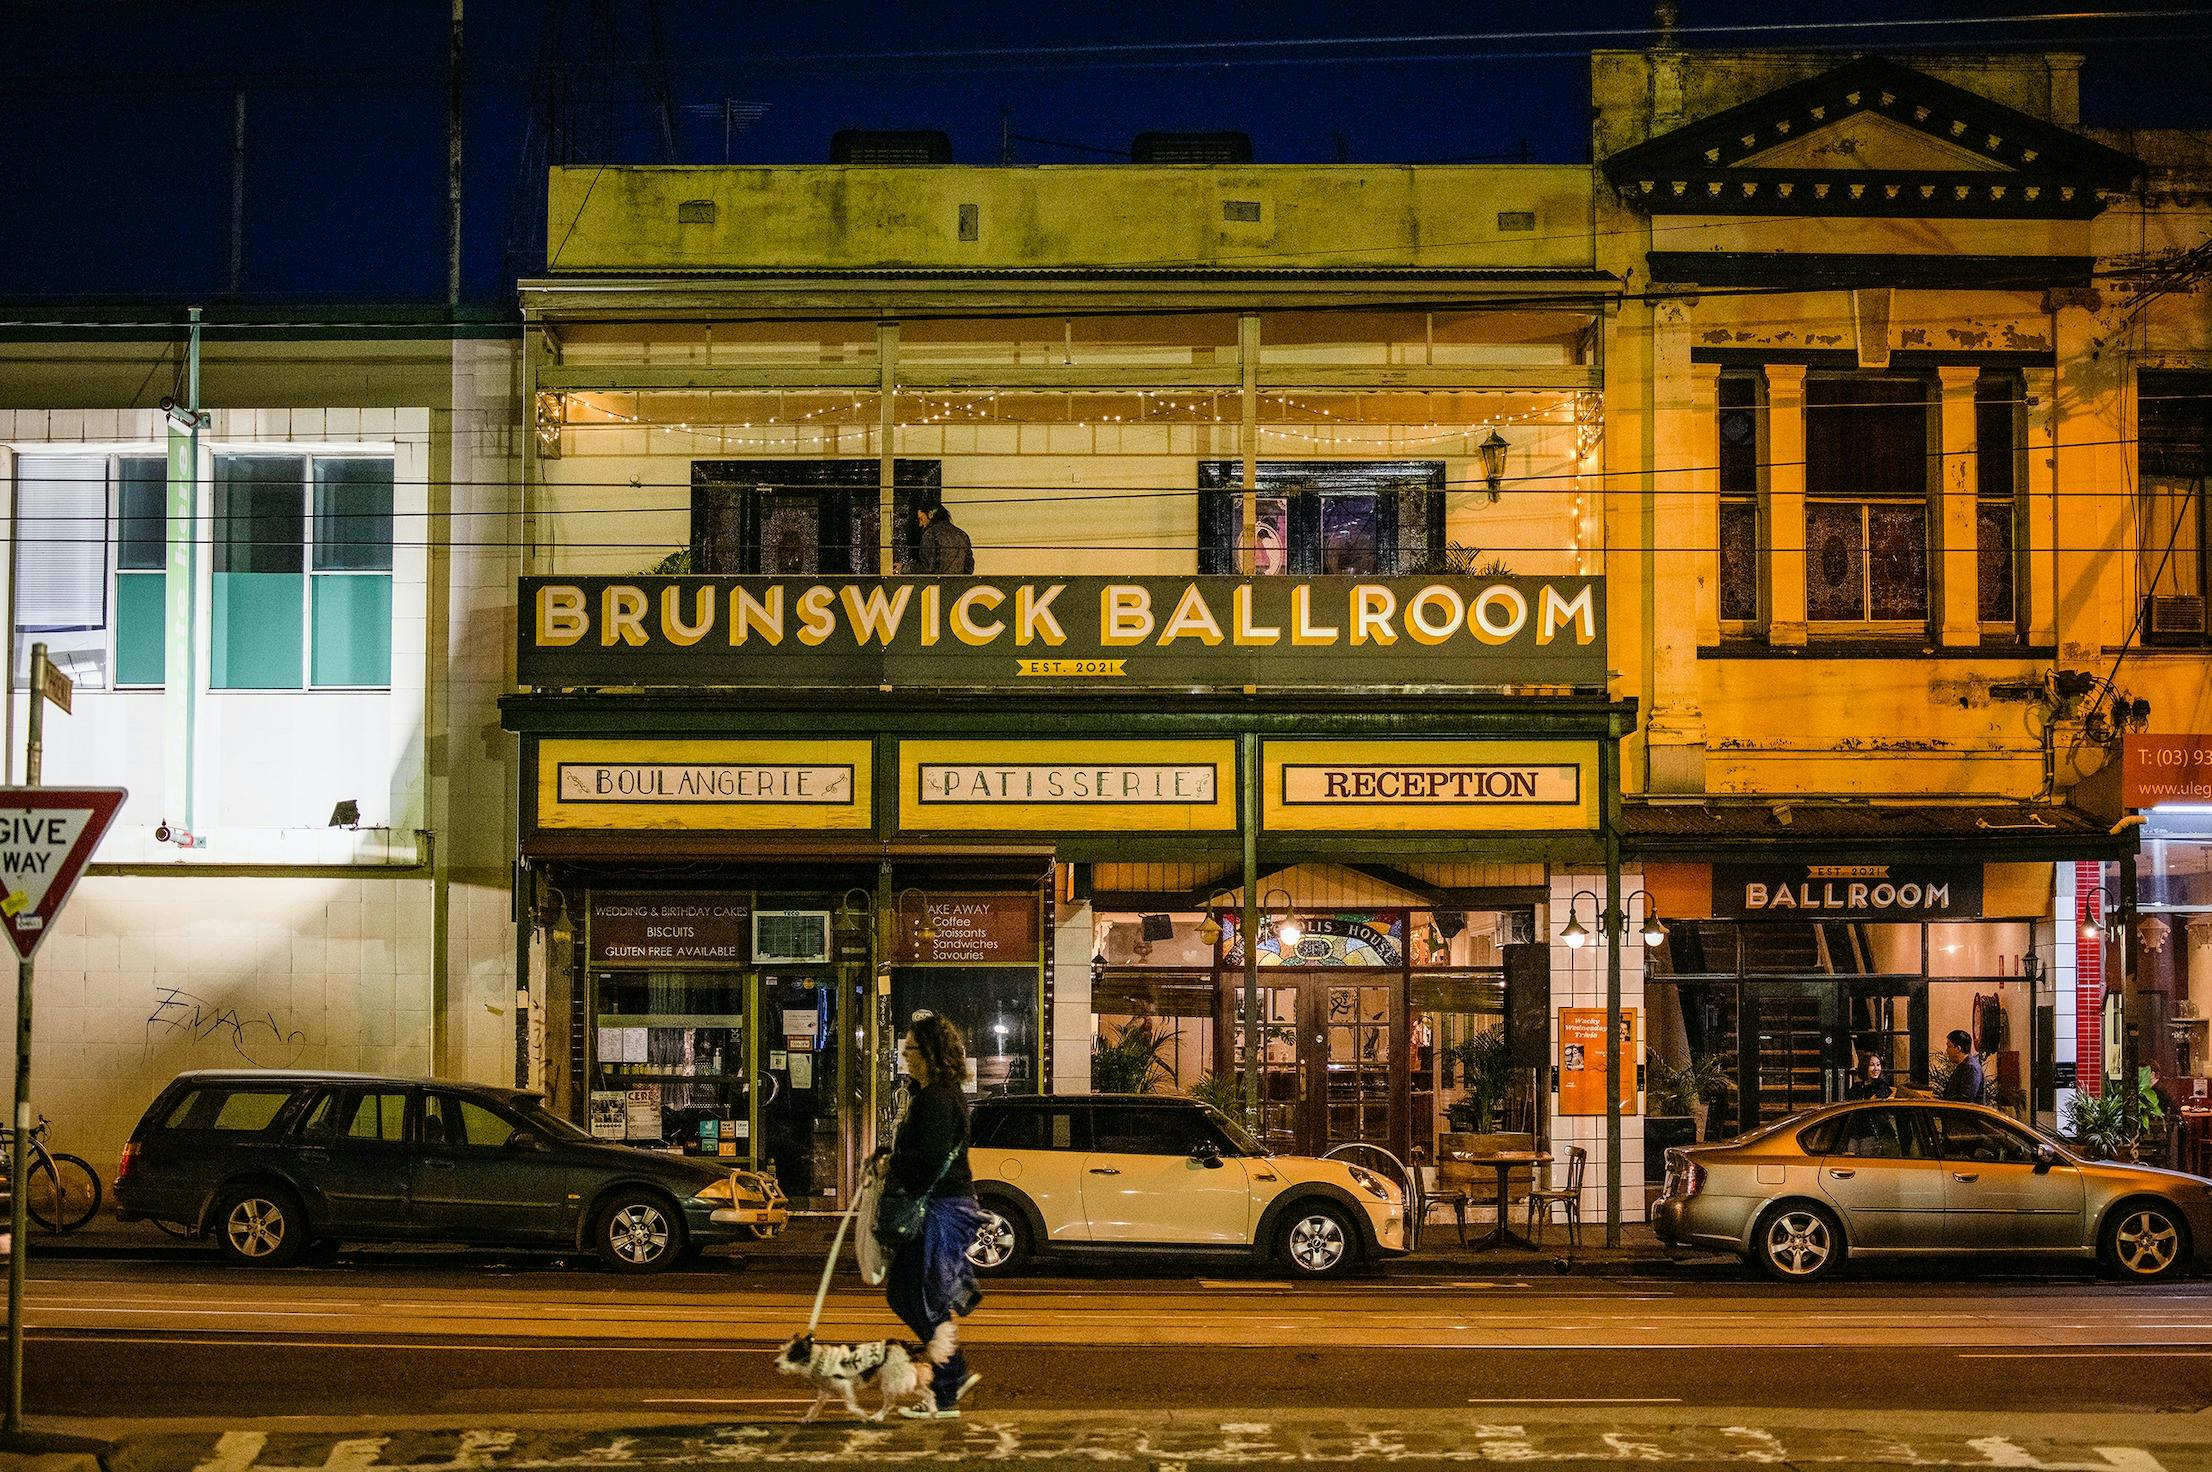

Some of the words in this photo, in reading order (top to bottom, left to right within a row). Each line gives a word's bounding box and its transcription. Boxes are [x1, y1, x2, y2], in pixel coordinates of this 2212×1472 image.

[536, 584, 1068, 647] BRUNSWICK
[1100, 583, 1596, 646] BALLROOM
[1031, 662, 1066, 673] EST.
[1076, 662, 1113, 673] 2021
[2137, 749, 2152, 765] T:
[2156, 748, 2189, 768] (03)
[594, 768, 814, 797] BOULANGERIE
[943, 770, 1192, 798] PATISSERIE
[1323, 771, 1539, 799] RECEPTION
[2138, 781, 2212, 799] www.uleg
[3, 851, 51, 873] WAY
[1851, 867, 1881, 876] 2021
[1745, 881, 1950, 909] BALLROOM
[595, 906, 648, 917] WEDDING
[650, 907, 659, 917] &
[661, 906, 711, 917] BIRTHDAY
[713, 906, 748, 917] CAKES
[927, 904, 950, 915] AKE
[952, 904, 990, 915] AWAY
[932, 916, 971, 927] Coffee
[646, 926, 695, 938] BISCUITS
[932, 938, 999, 949] Sandwiches
[1348, 923, 1397, 963] HOUSE
[605, 946, 646, 957] GLUTEN
[648, 946, 673, 957] FREE
[676, 946, 736, 957] AVAILABLE
[932, 949, 985, 960] Savouries
[1575, 1018, 1600, 1026] Wacky
[1565, 1024, 1608, 1032] Wednesday
